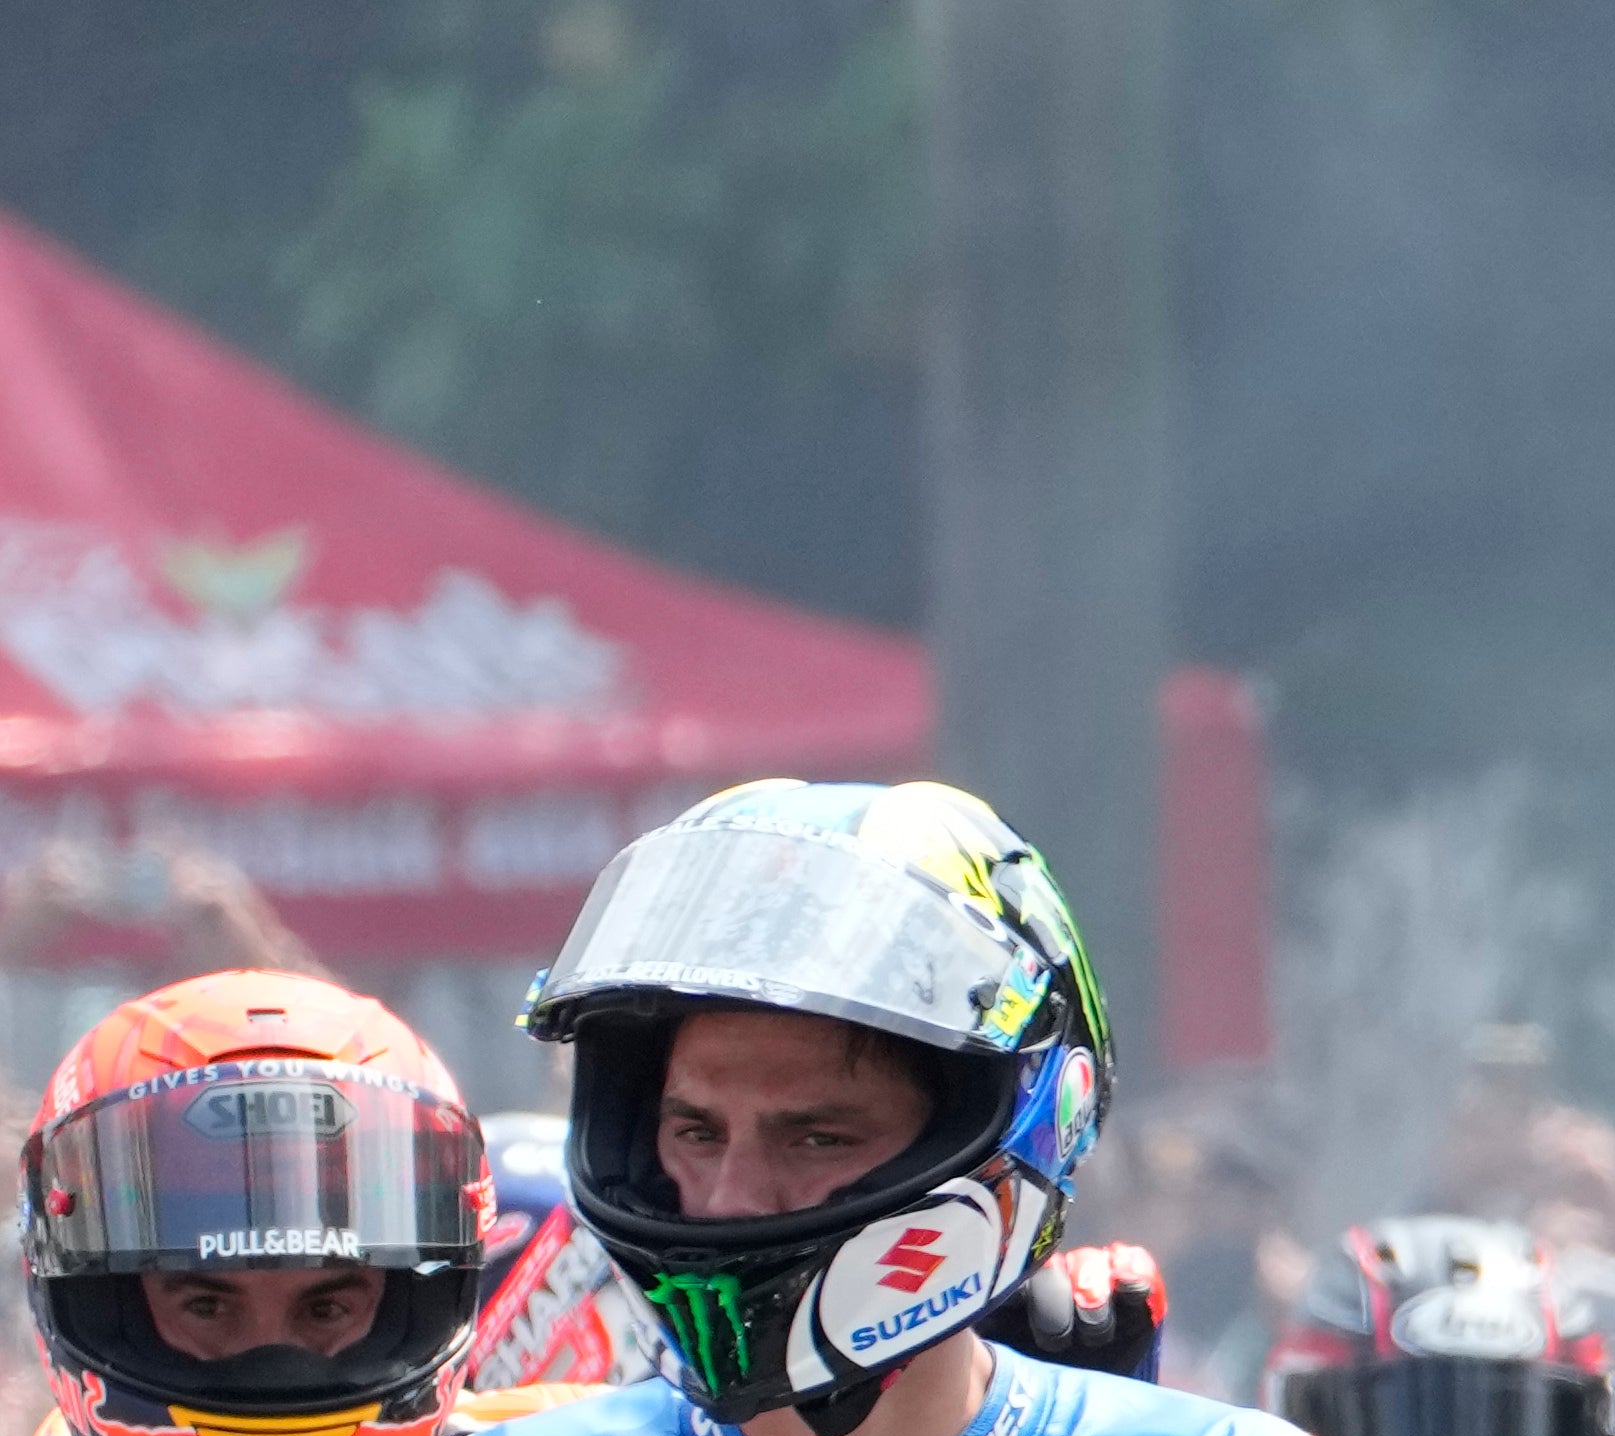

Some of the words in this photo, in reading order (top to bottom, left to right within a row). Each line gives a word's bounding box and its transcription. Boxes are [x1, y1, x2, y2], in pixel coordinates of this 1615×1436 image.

[128, 1064, 219, 1100] GIVES
[236, 1060, 305, 1079] YOU
[320, 1060, 420, 1100] WINGS
[207, 1091, 336, 1131] SHOEI
[200, 1228, 360, 1261] PULL&BEAR
[851, 1271, 983, 1350] SUZUKI
